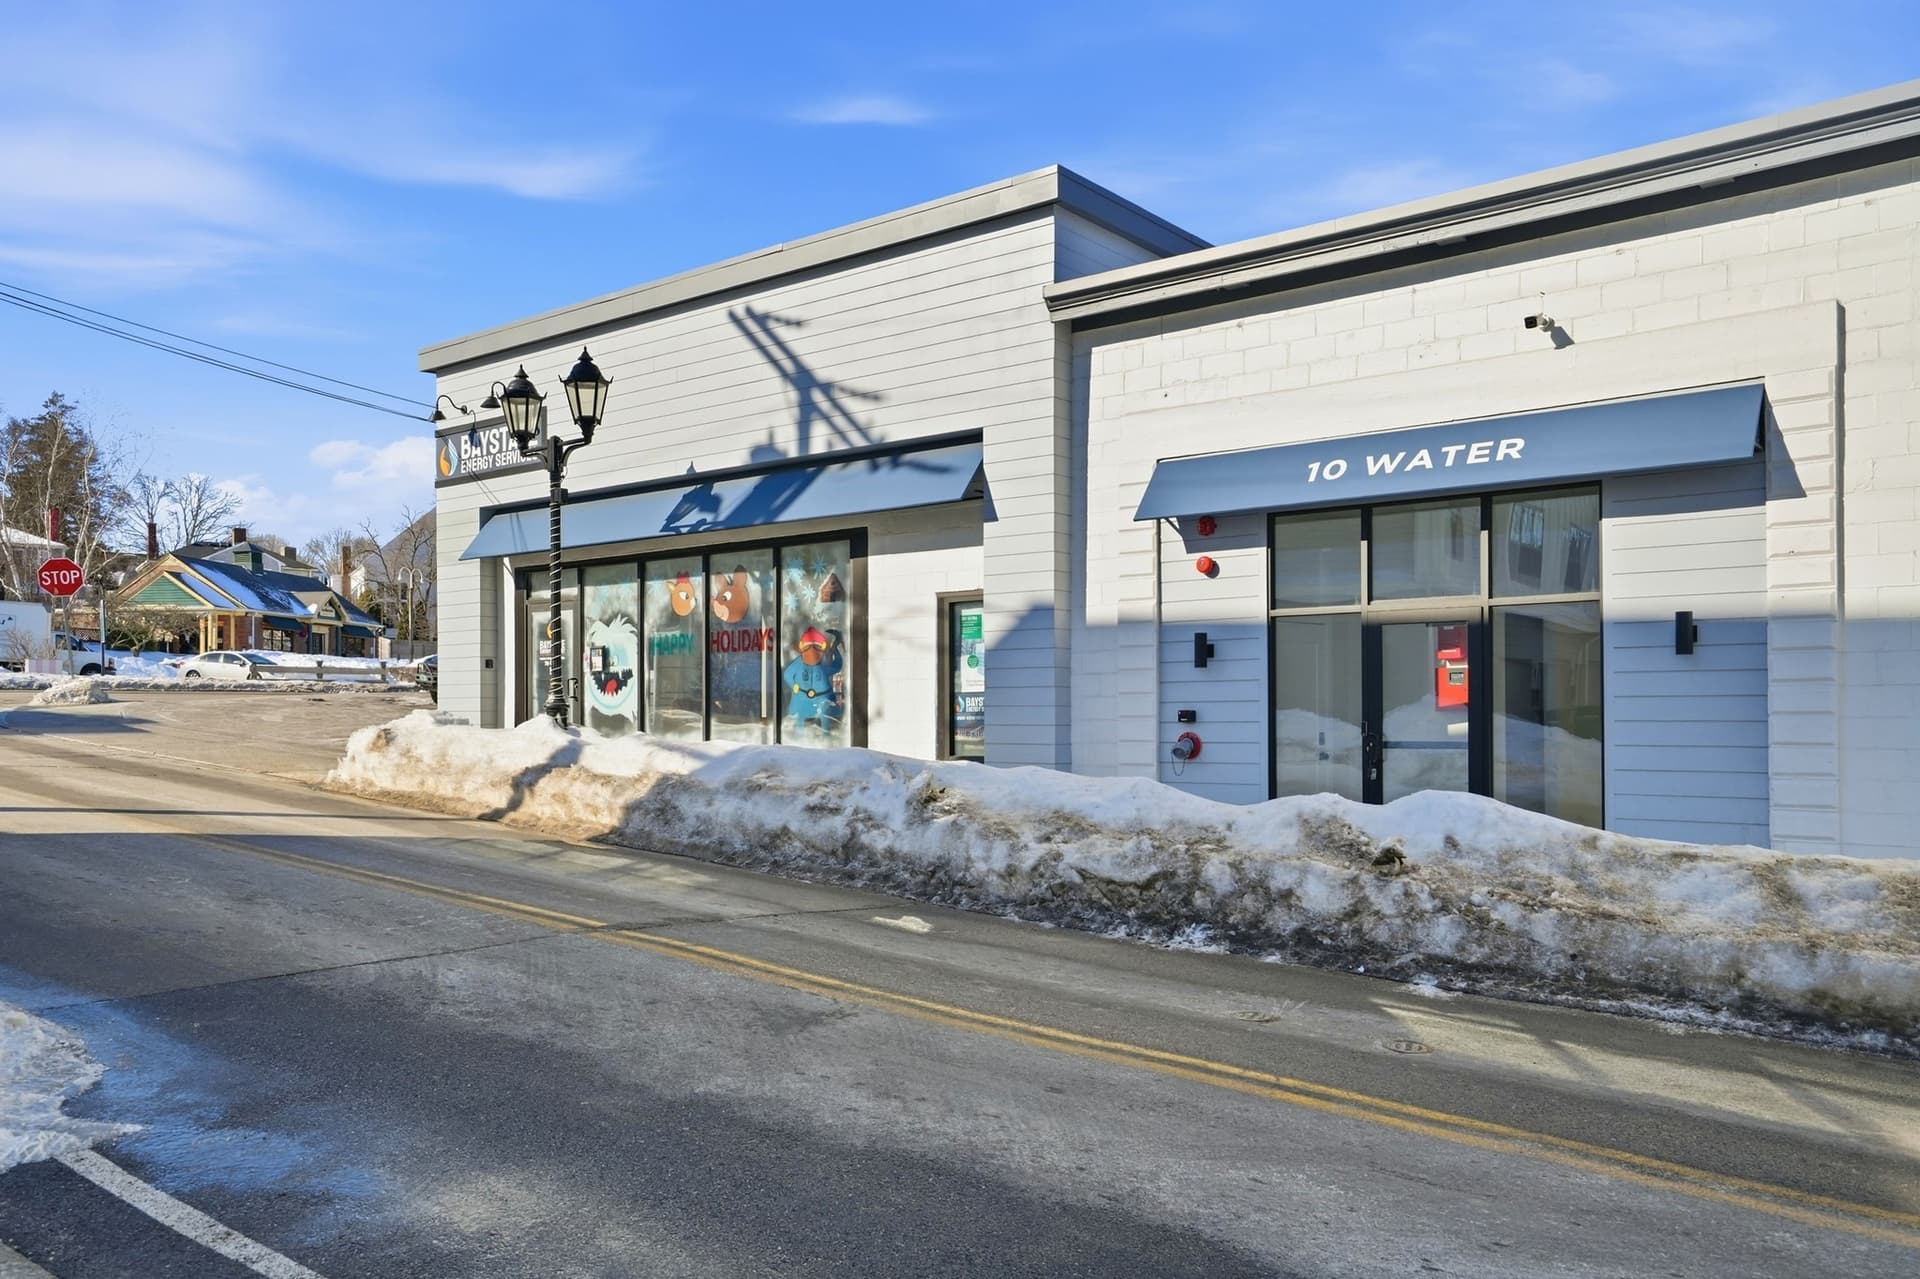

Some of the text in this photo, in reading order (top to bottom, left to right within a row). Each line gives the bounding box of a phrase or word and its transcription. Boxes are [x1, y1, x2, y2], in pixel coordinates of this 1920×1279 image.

[461, 455, 494, 473] ENERGY
[1307, 438, 1526, 483] 10 WATER
[42, 570, 80, 585] STOP
[650, 628, 774, 656] HAPPY HOLIDAYS
